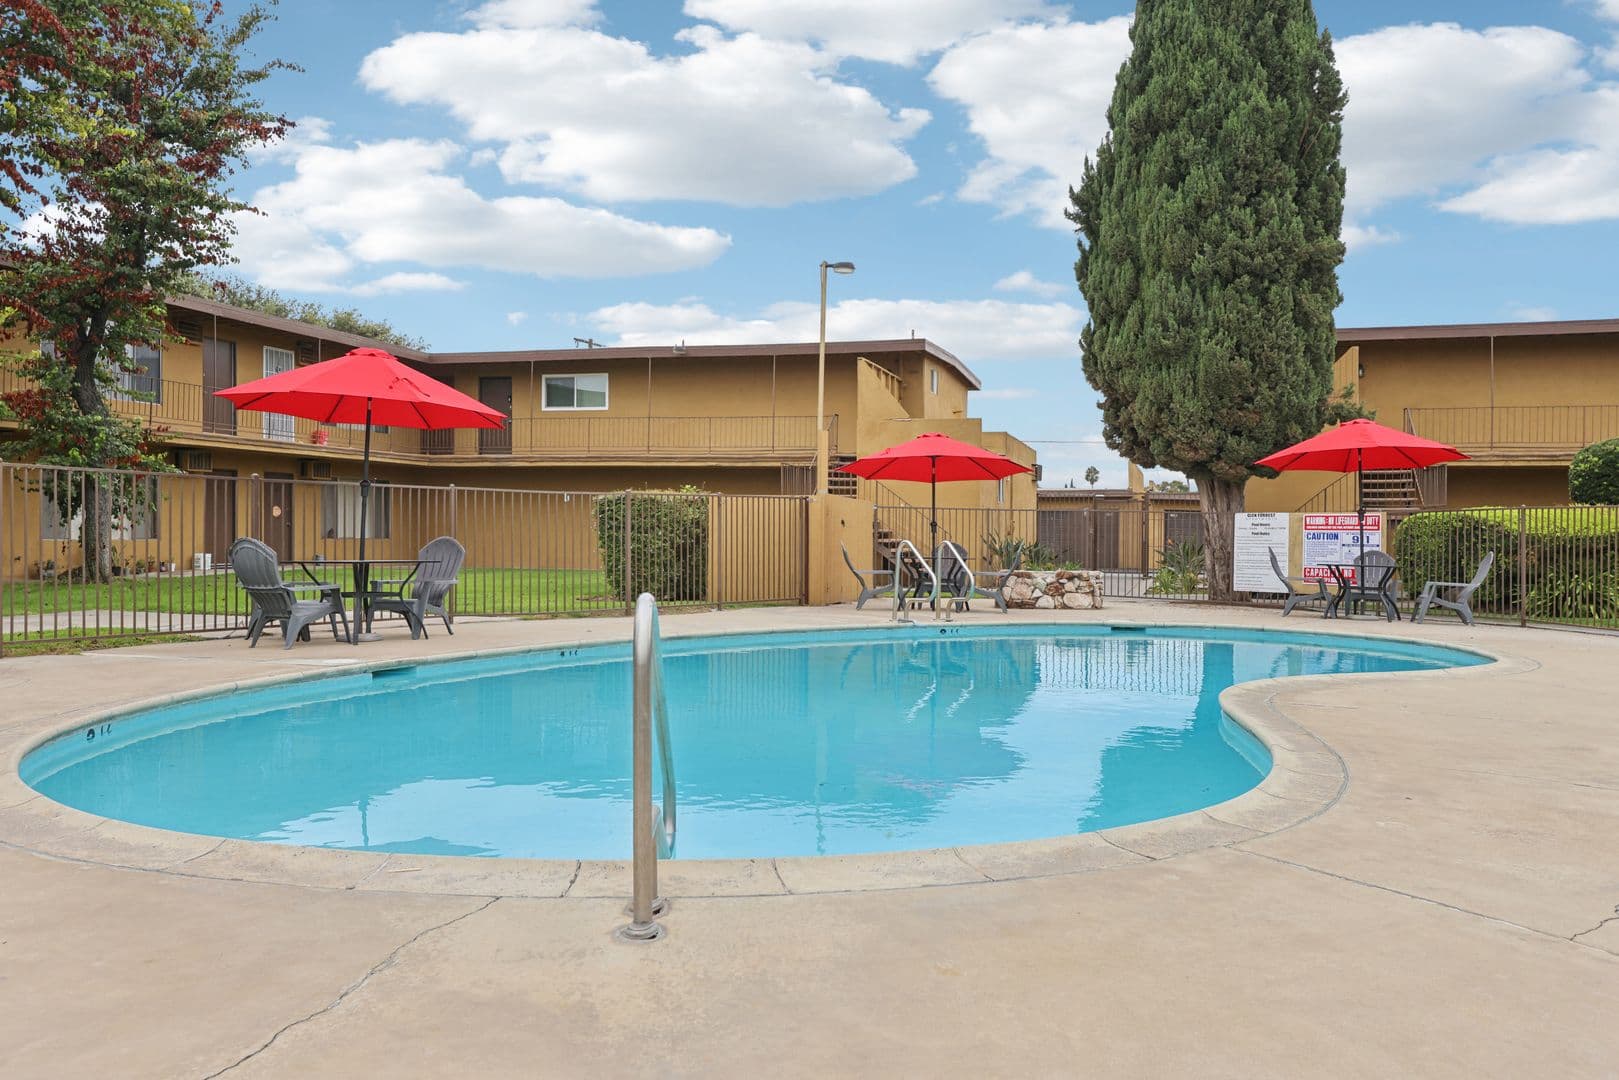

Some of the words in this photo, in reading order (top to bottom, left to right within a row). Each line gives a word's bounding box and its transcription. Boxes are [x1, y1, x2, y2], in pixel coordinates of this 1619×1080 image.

[1366, 516, 1379, 525] DUTY
[1306, 532, 1339, 540] CAUTION
[1352, 535, 1370, 544] 91
